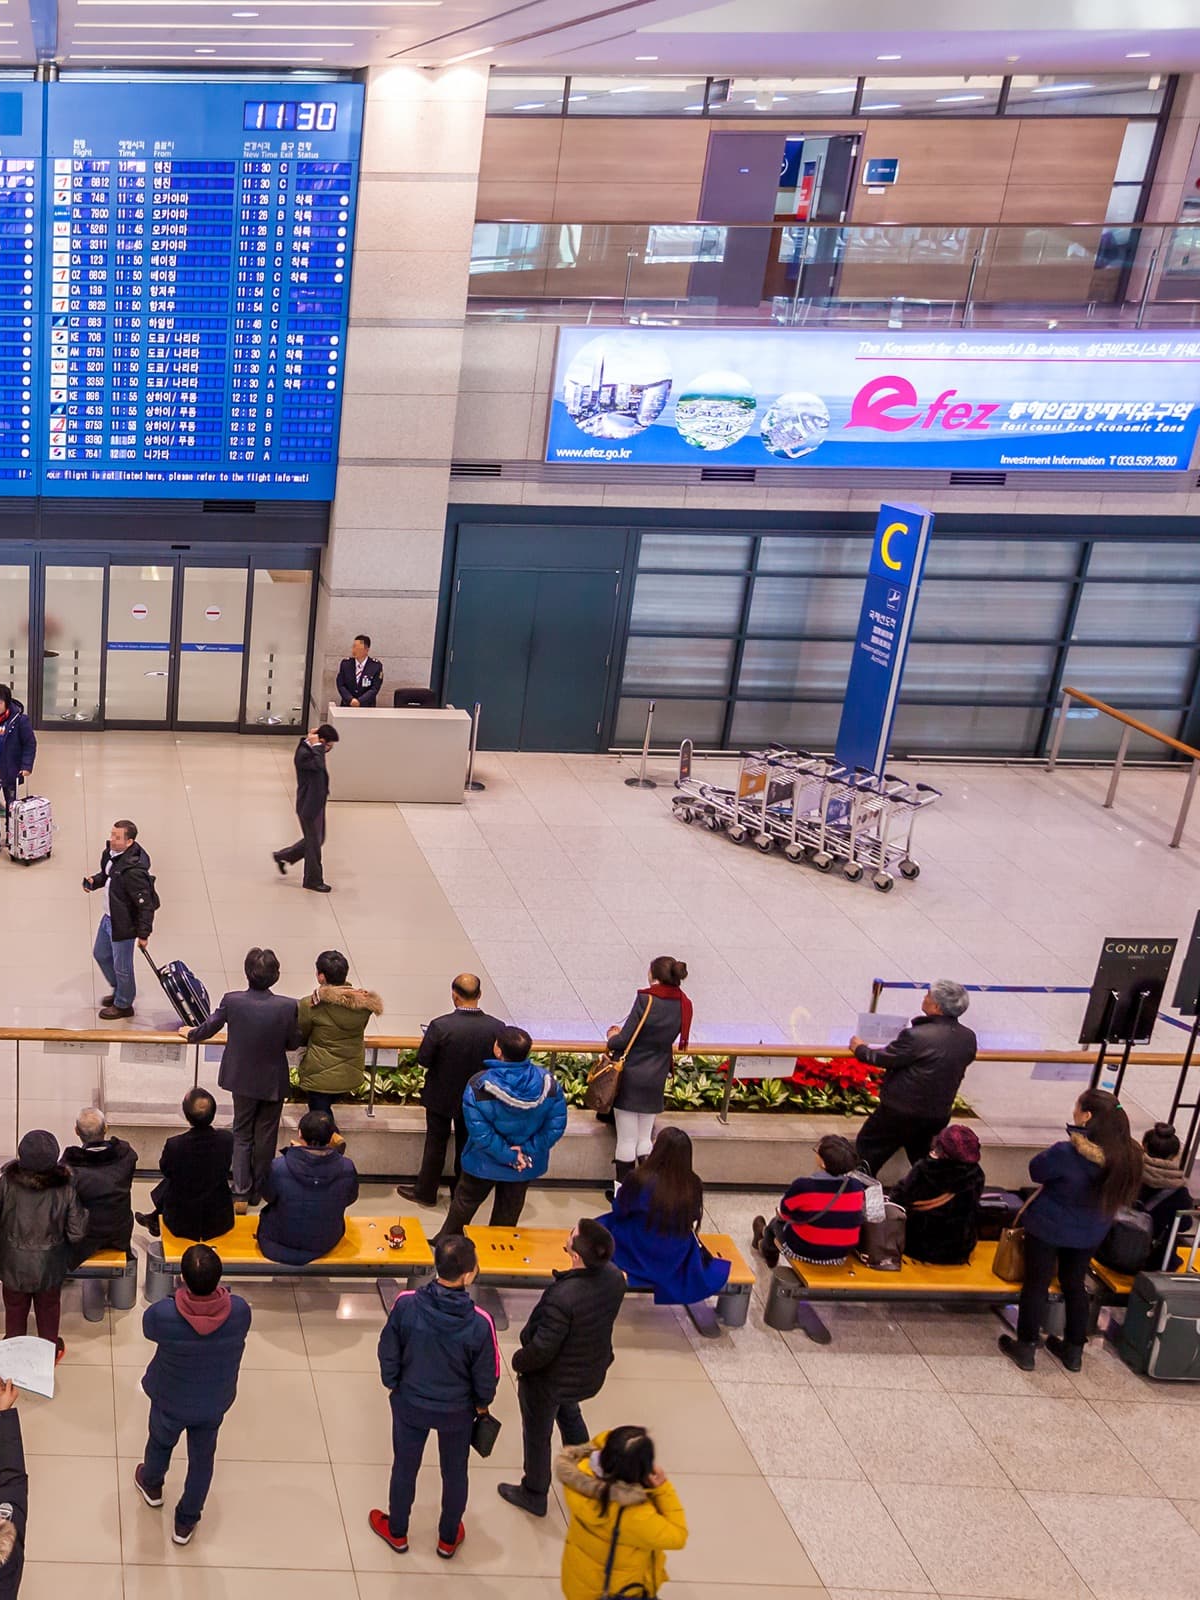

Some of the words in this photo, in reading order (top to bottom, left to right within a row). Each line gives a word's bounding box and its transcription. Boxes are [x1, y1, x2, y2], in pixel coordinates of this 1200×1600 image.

[73, 149, 93, 158] Flight
[119, 149, 136, 157] Time
[154, 150, 172, 158] From
[243, 151, 259, 159] New
[261, 151, 278, 159] Time
[280, 151, 294, 159] Exit
[297, 151, 319, 159] Status
[73, 161, 84, 171] CA
[71, 255, 81, 264] CA
[857, 341, 881, 354] The
[268, 365, 275, 374] A
[1000, 421, 1027, 432] East
[1029, 422, 1063, 432] coast
[1065, 422, 1093, 433] Free
[1094, 422, 1152, 433] Economic
[1154, 423, 1185, 433] Zone
[556, 447, 633, 460] www.efez.go.kr
[1000, 454, 1051, 466] Investment
[1051, 455, 1105, 466] Information
[1109, 456, 1116, 466] T
[1116, 456, 1178, 467] 033.539.7800
[64, 470, 88, 481] flight
[220, 472, 229, 481] to
[232, 472, 244, 481] the
[247, 473, 271, 483] flight
[880, 522, 909, 571] C
[1104, 943, 1172, 954] CONRAD
